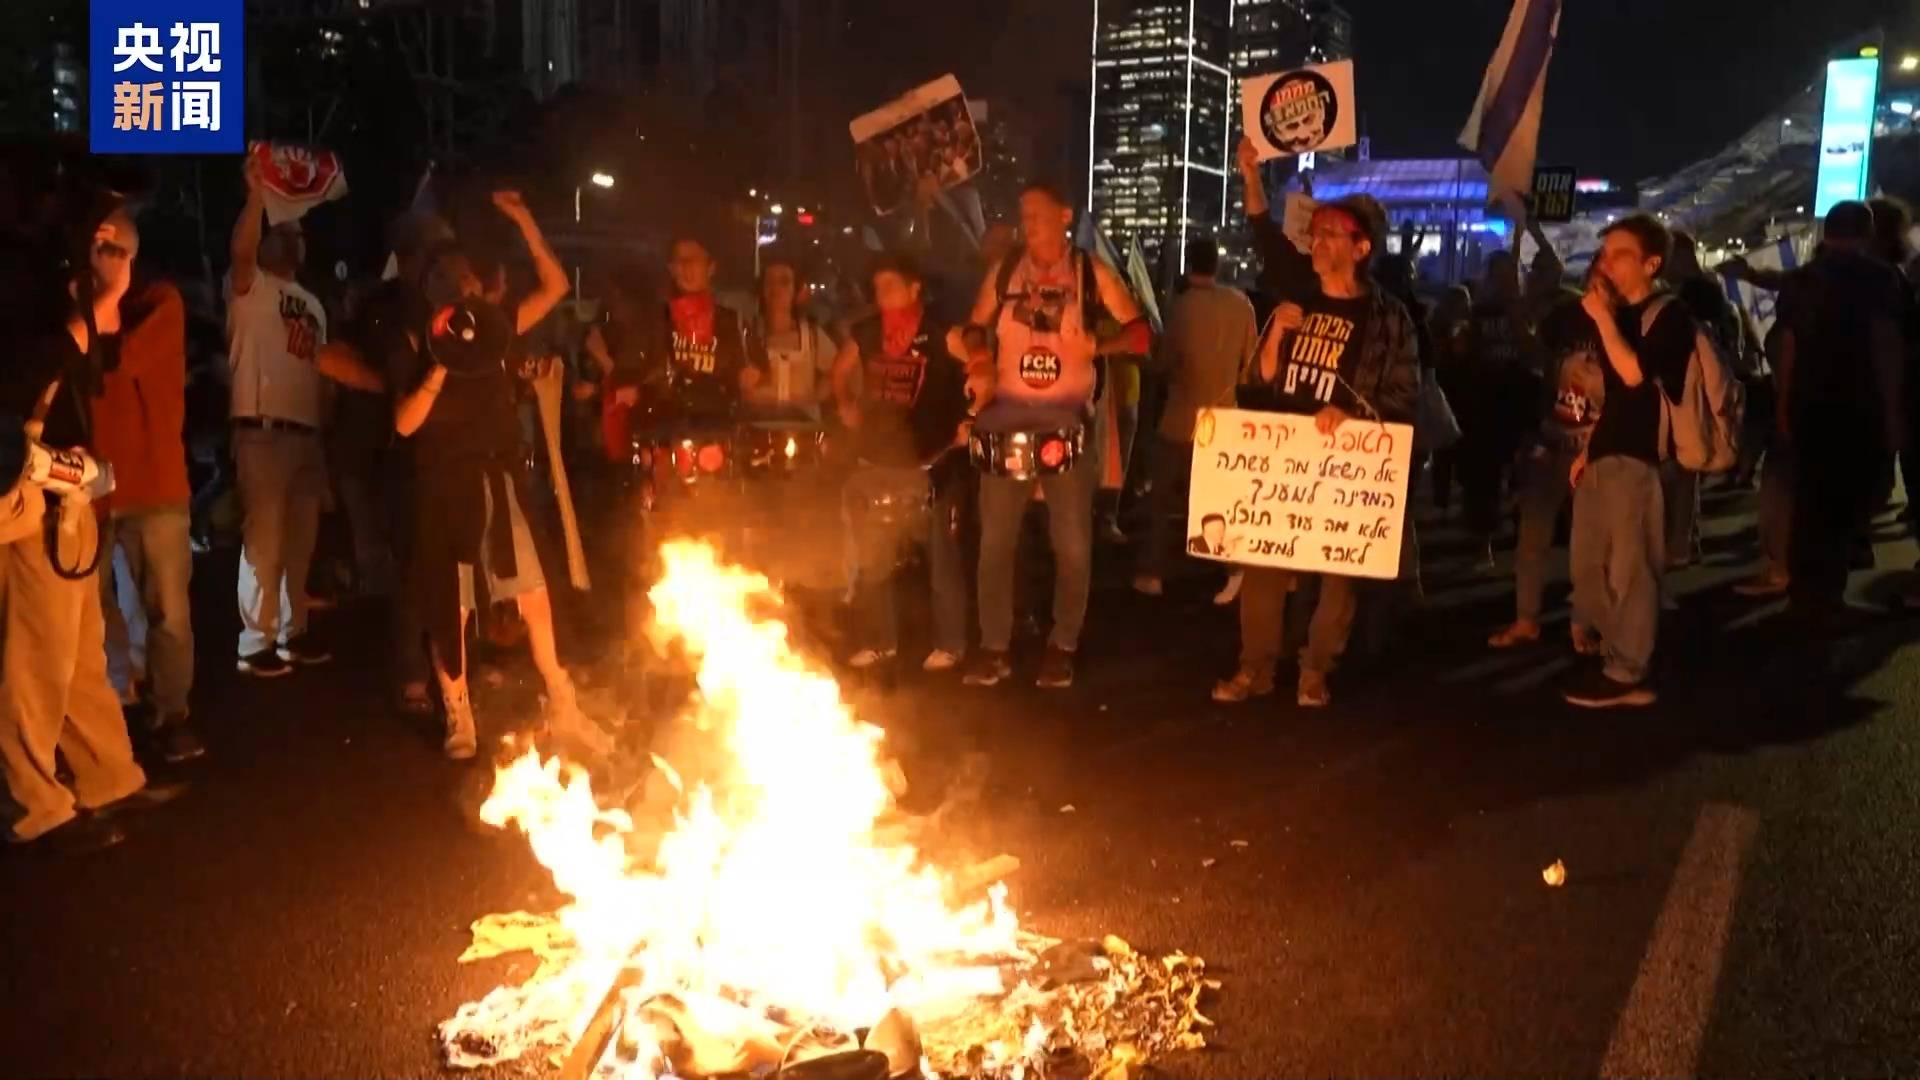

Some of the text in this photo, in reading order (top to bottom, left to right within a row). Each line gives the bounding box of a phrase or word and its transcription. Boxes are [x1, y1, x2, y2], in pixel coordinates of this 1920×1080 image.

[1023, 354, 1057, 369] FCK
[1291, 335, 1345, 369] אותנו
[1283, 363, 1336, 403] חיים
[1241, 421, 1297, 449] יקרה
[1216, 451, 1270, 473] עשתה
[1284, 458, 1310, 475] מה
[1374, 457, 1398, 483] אל
[1333, 488, 1395, 509] המדינה
[1324, 518, 1348, 532] מה
